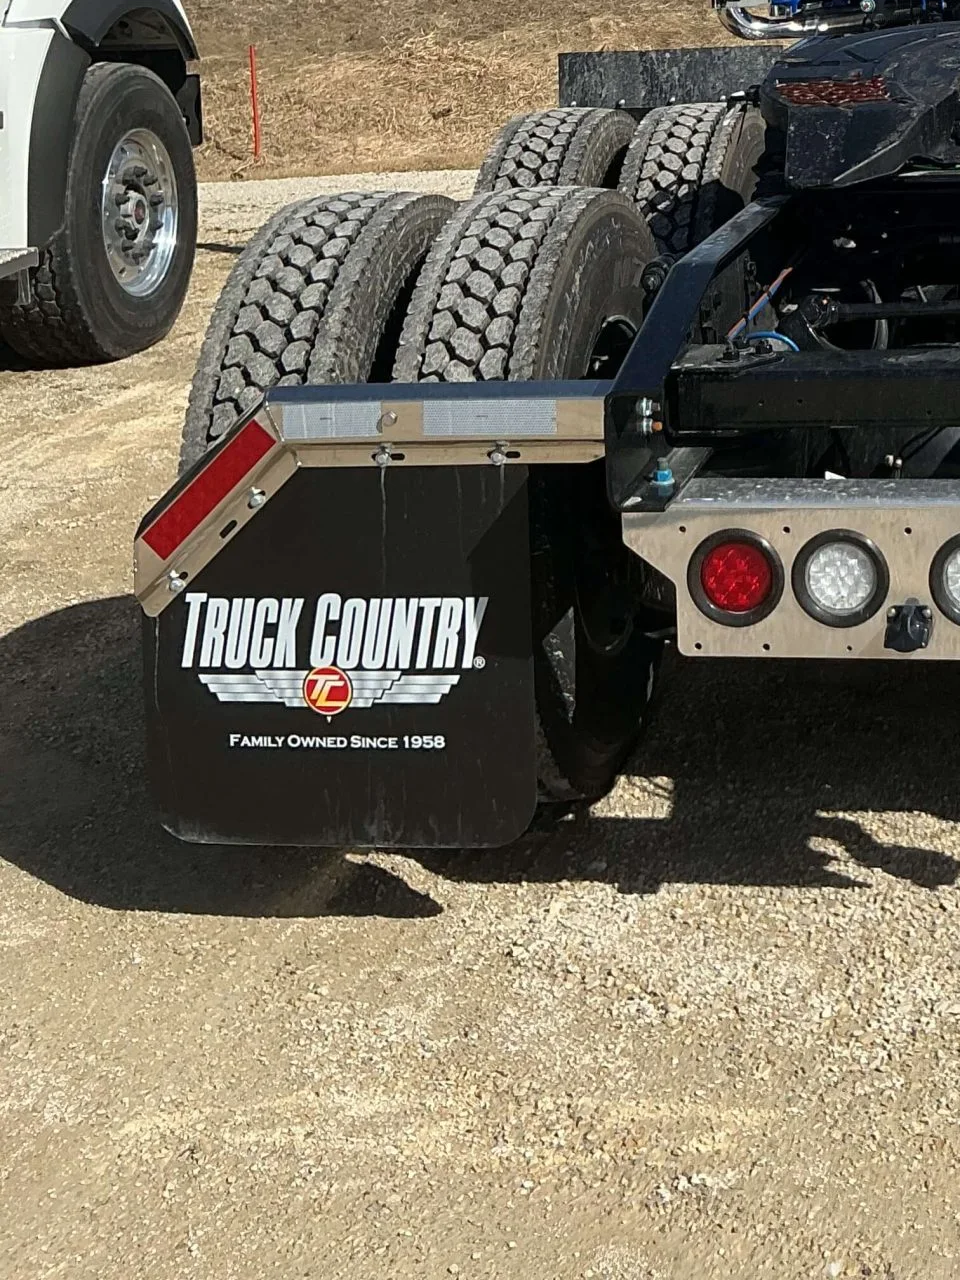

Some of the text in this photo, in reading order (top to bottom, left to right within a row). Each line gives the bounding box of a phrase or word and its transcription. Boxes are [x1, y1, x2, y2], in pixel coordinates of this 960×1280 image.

[181, 592, 305, 669] TRUCK
[229, 733, 446, 749] FAMILY OWNED SINCE 1958
